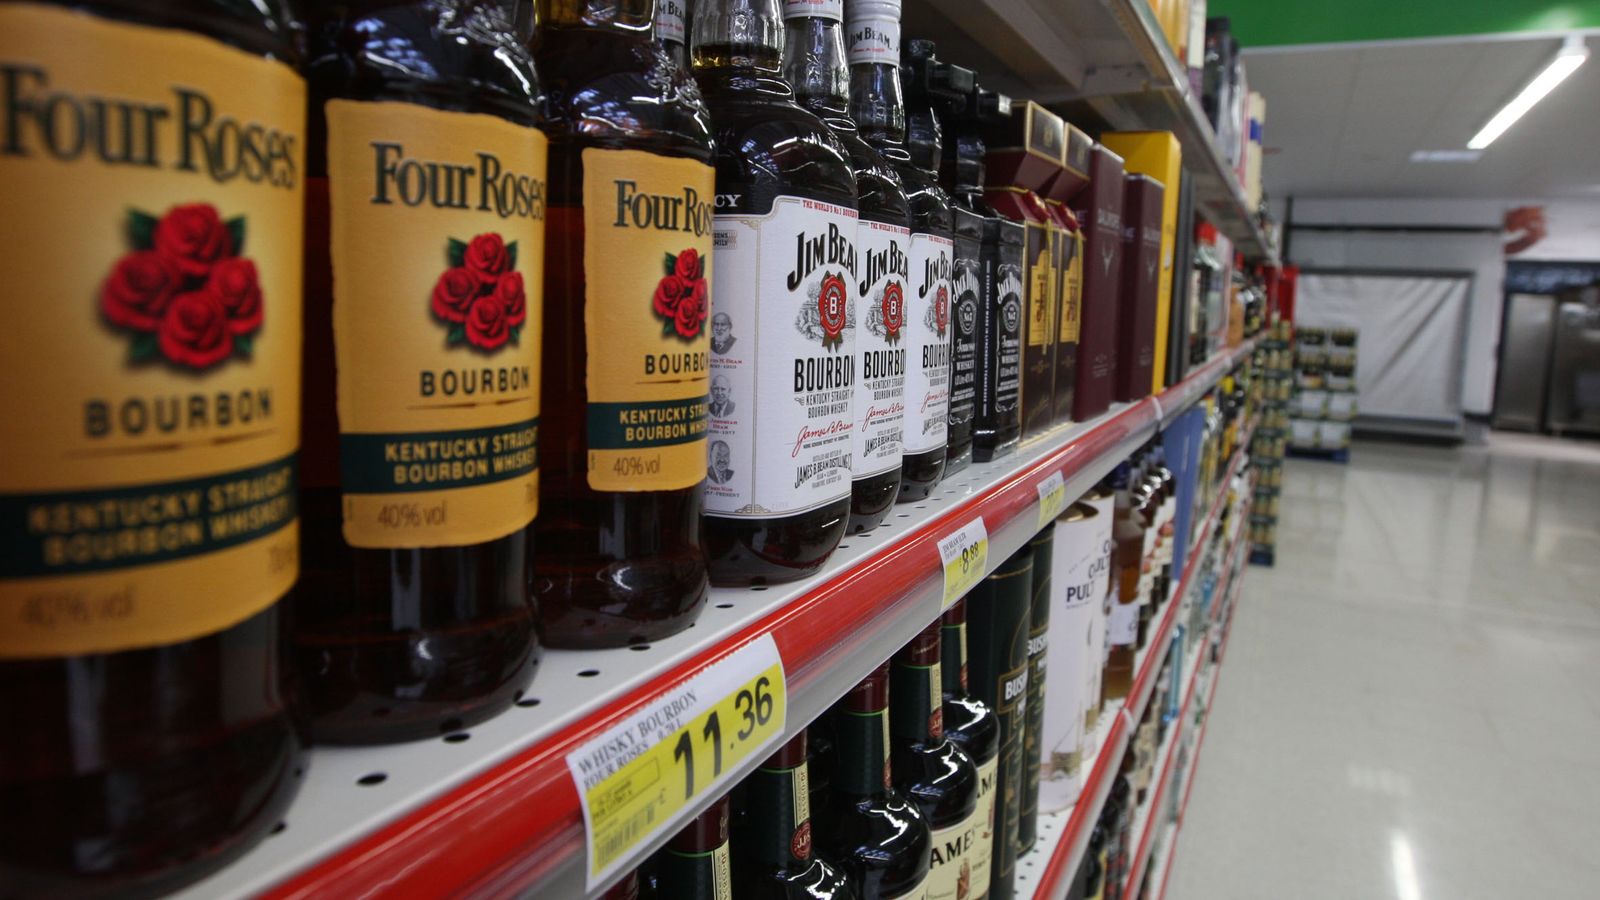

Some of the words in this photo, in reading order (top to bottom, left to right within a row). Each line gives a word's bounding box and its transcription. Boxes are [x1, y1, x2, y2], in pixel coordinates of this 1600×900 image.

[864, 26, 890, 49] BEAM
[0, 63, 172, 168] Four
[171, 85, 297, 189] Roses
[369, 140, 477, 210] Four
[475, 151, 545, 221] Roses
[612, 179, 683, 231] Four
[787, 231, 826, 293] JIM
[859, 248, 888, 298] JIM
[919, 257, 940, 299] JIM
[830, 296, 838, 315] B
[890, 300, 897, 316] B
[420, 366, 529, 397] BOURBON
[794, 355, 856, 393] BOURBON
[84, 389, 270, 438] BOURBON
[806, 392, 830, 406] KENTUCKY
[808, 405, 830, 418] BOURBON
[619, 405, 687, 425] KENTUCKY
[625, 423, 687, 442] BOURBON
[384, 437, 488, 462] KENTUCKY
[613, 456, 644, 477] 40%
[645, 453, 661, 475] vol
[393, 458, 488, 485] BOURBON
[28, 489, 202, 534] KENTUCKY
[377, 502, 420, 529] 40%
[424, 499, 447, 526] vol
[43, 520, 203, 565] BOURBON
[578, 730, 635, 775] WHISKY
[637, 690, 697, 738] BOURBON
